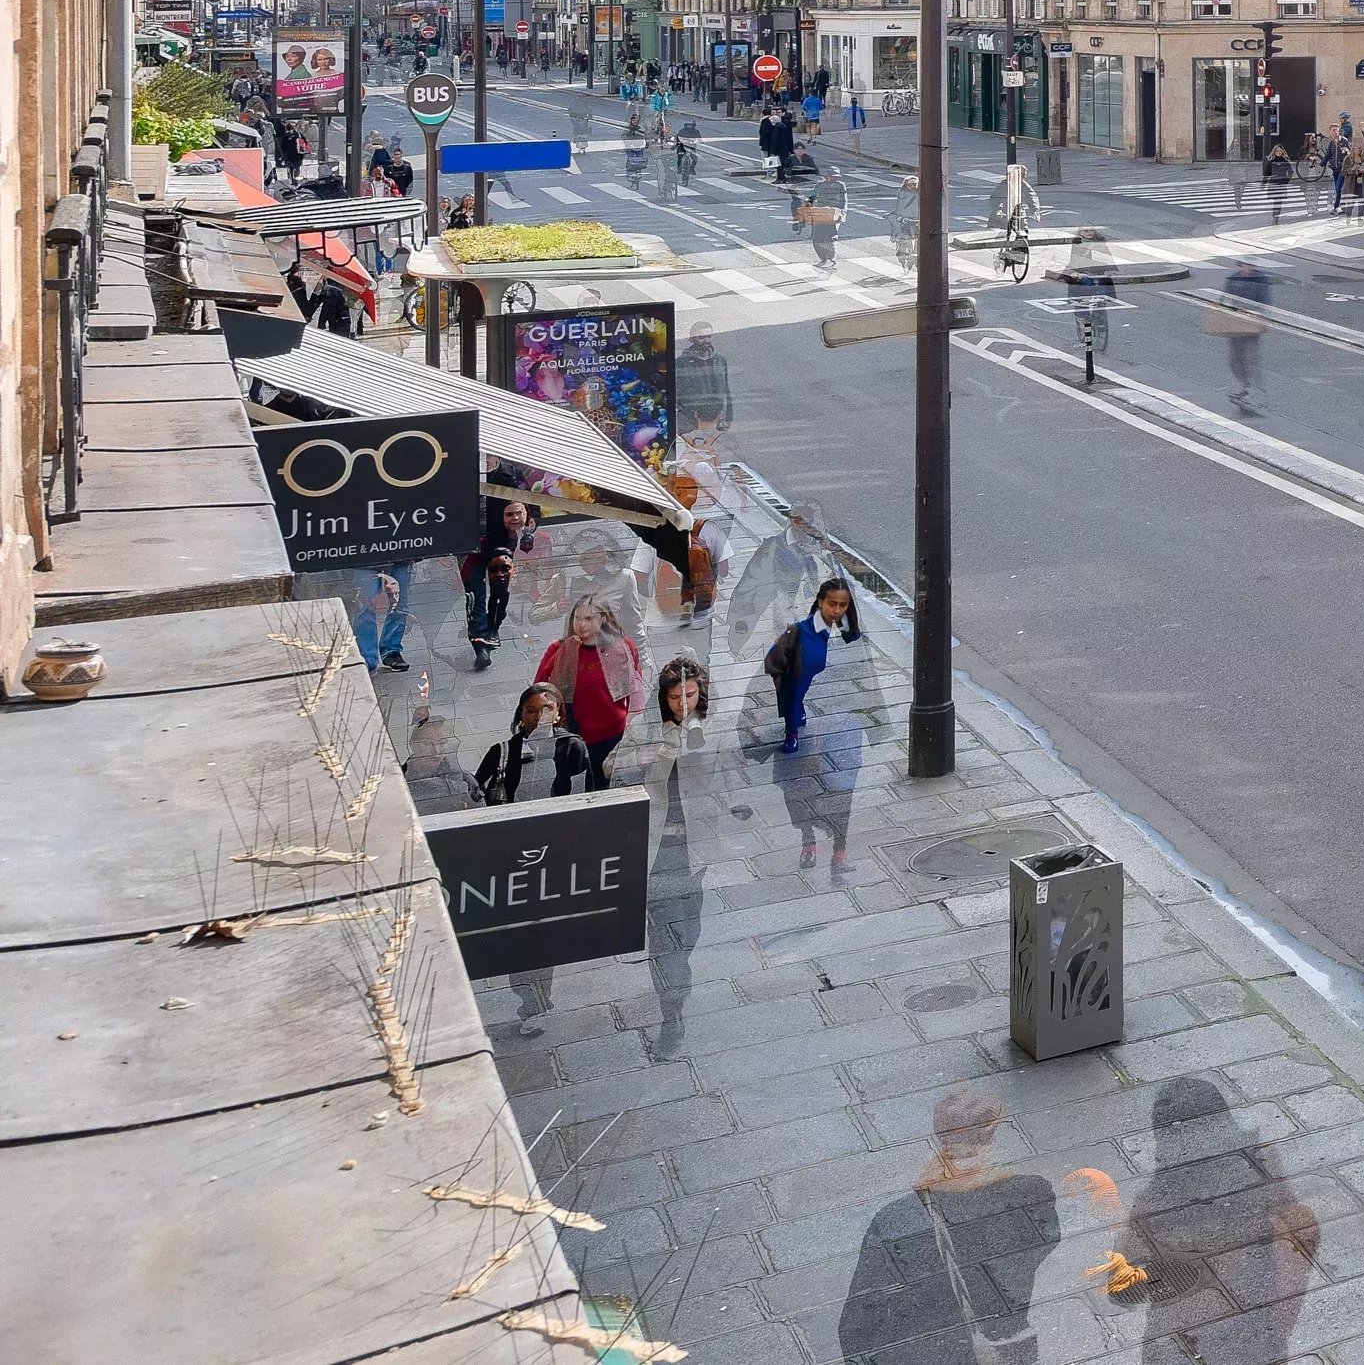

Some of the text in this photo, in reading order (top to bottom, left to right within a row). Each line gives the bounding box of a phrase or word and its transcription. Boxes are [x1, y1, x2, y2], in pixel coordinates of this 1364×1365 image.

[156, 13, 191, 21] MONTRERIE
[413, 86, 450, 103] BUS
[529, 317, 656, 343] GUERLAIN
[578, 339, 607, 348] PARIS
[539, 352, 645, 370] AQUA ALLEGORIA
[566, 365, 619, 375] FLORABLOOM
[284, 498, 446, 540] Jim Eyes
[296, 537, 433, 562] OPTIQUE & AUDITION
